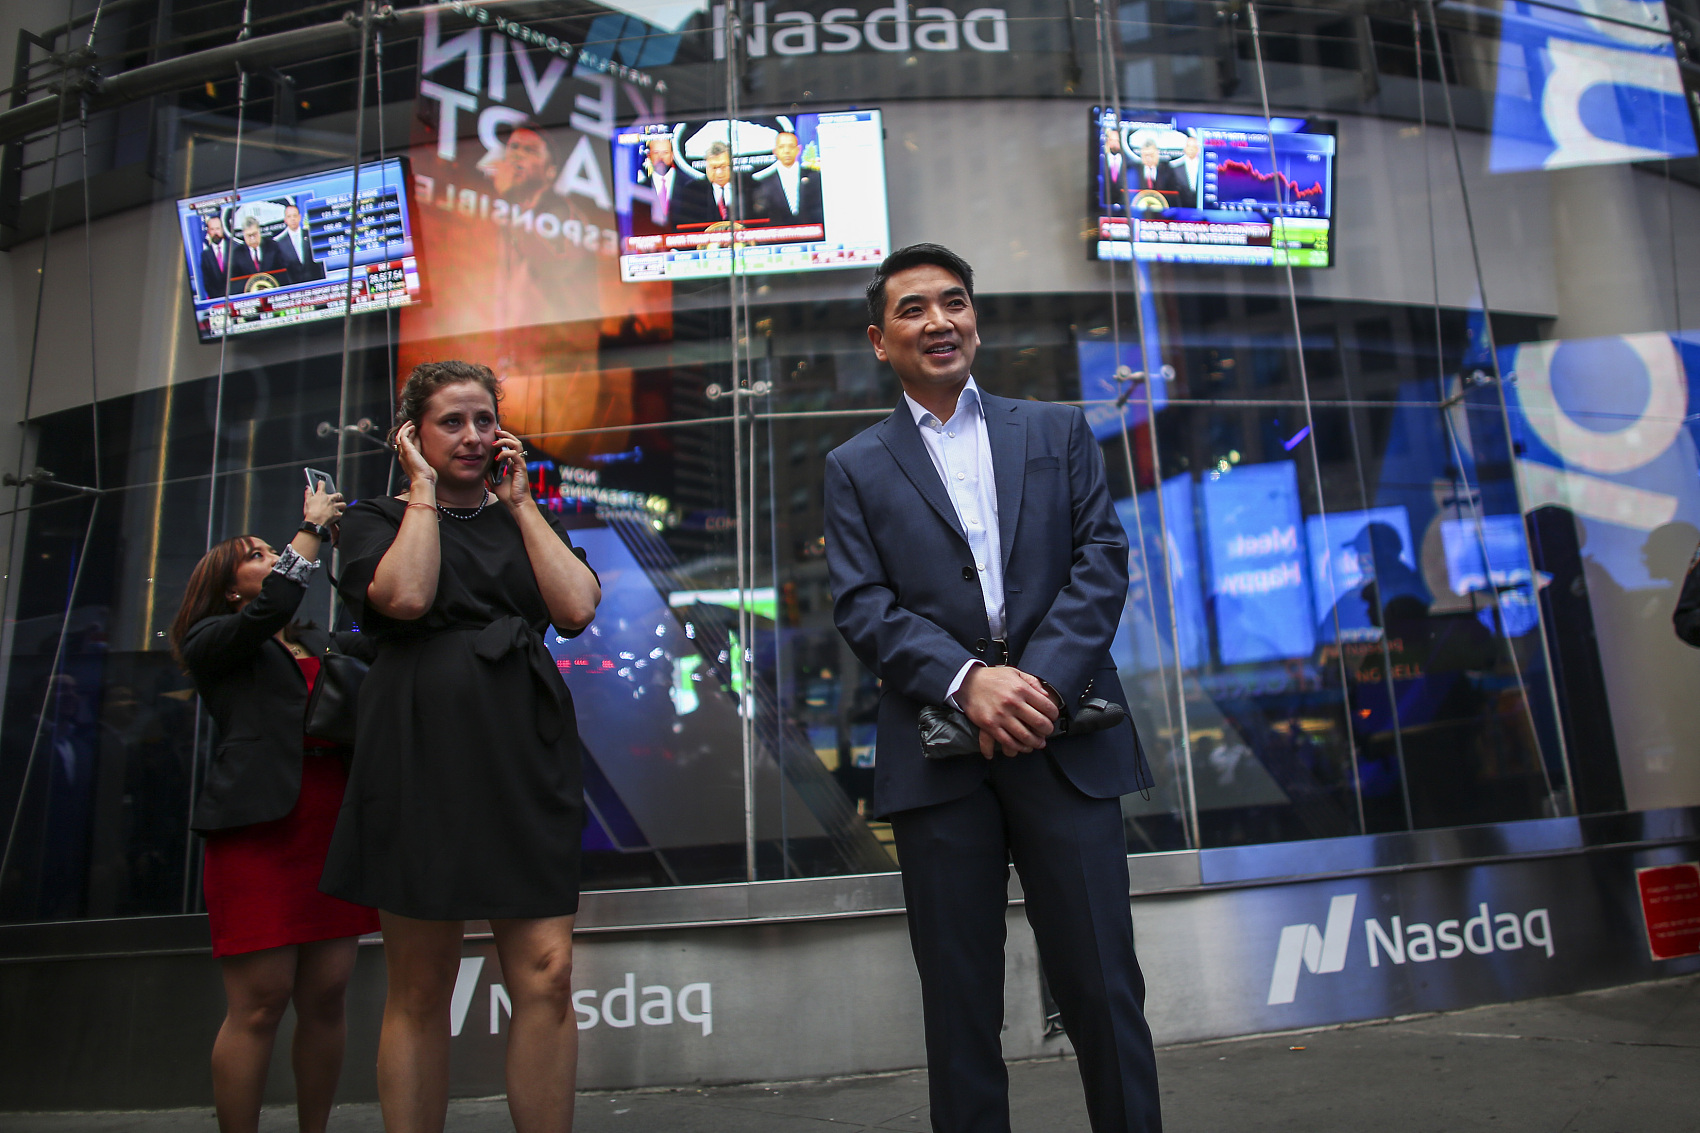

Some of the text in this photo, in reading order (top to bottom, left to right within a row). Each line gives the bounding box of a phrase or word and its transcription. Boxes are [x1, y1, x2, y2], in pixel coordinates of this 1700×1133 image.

[712, 0, 1009, 60] Nasdaq
[1183, 232, 1198, 243] TO
[1209, 223, 1272, 237] GOVERNMENT
[1365, 902, 1556, 968] Nasdaq
[489, 972, 713, 1037] Nsdaq
